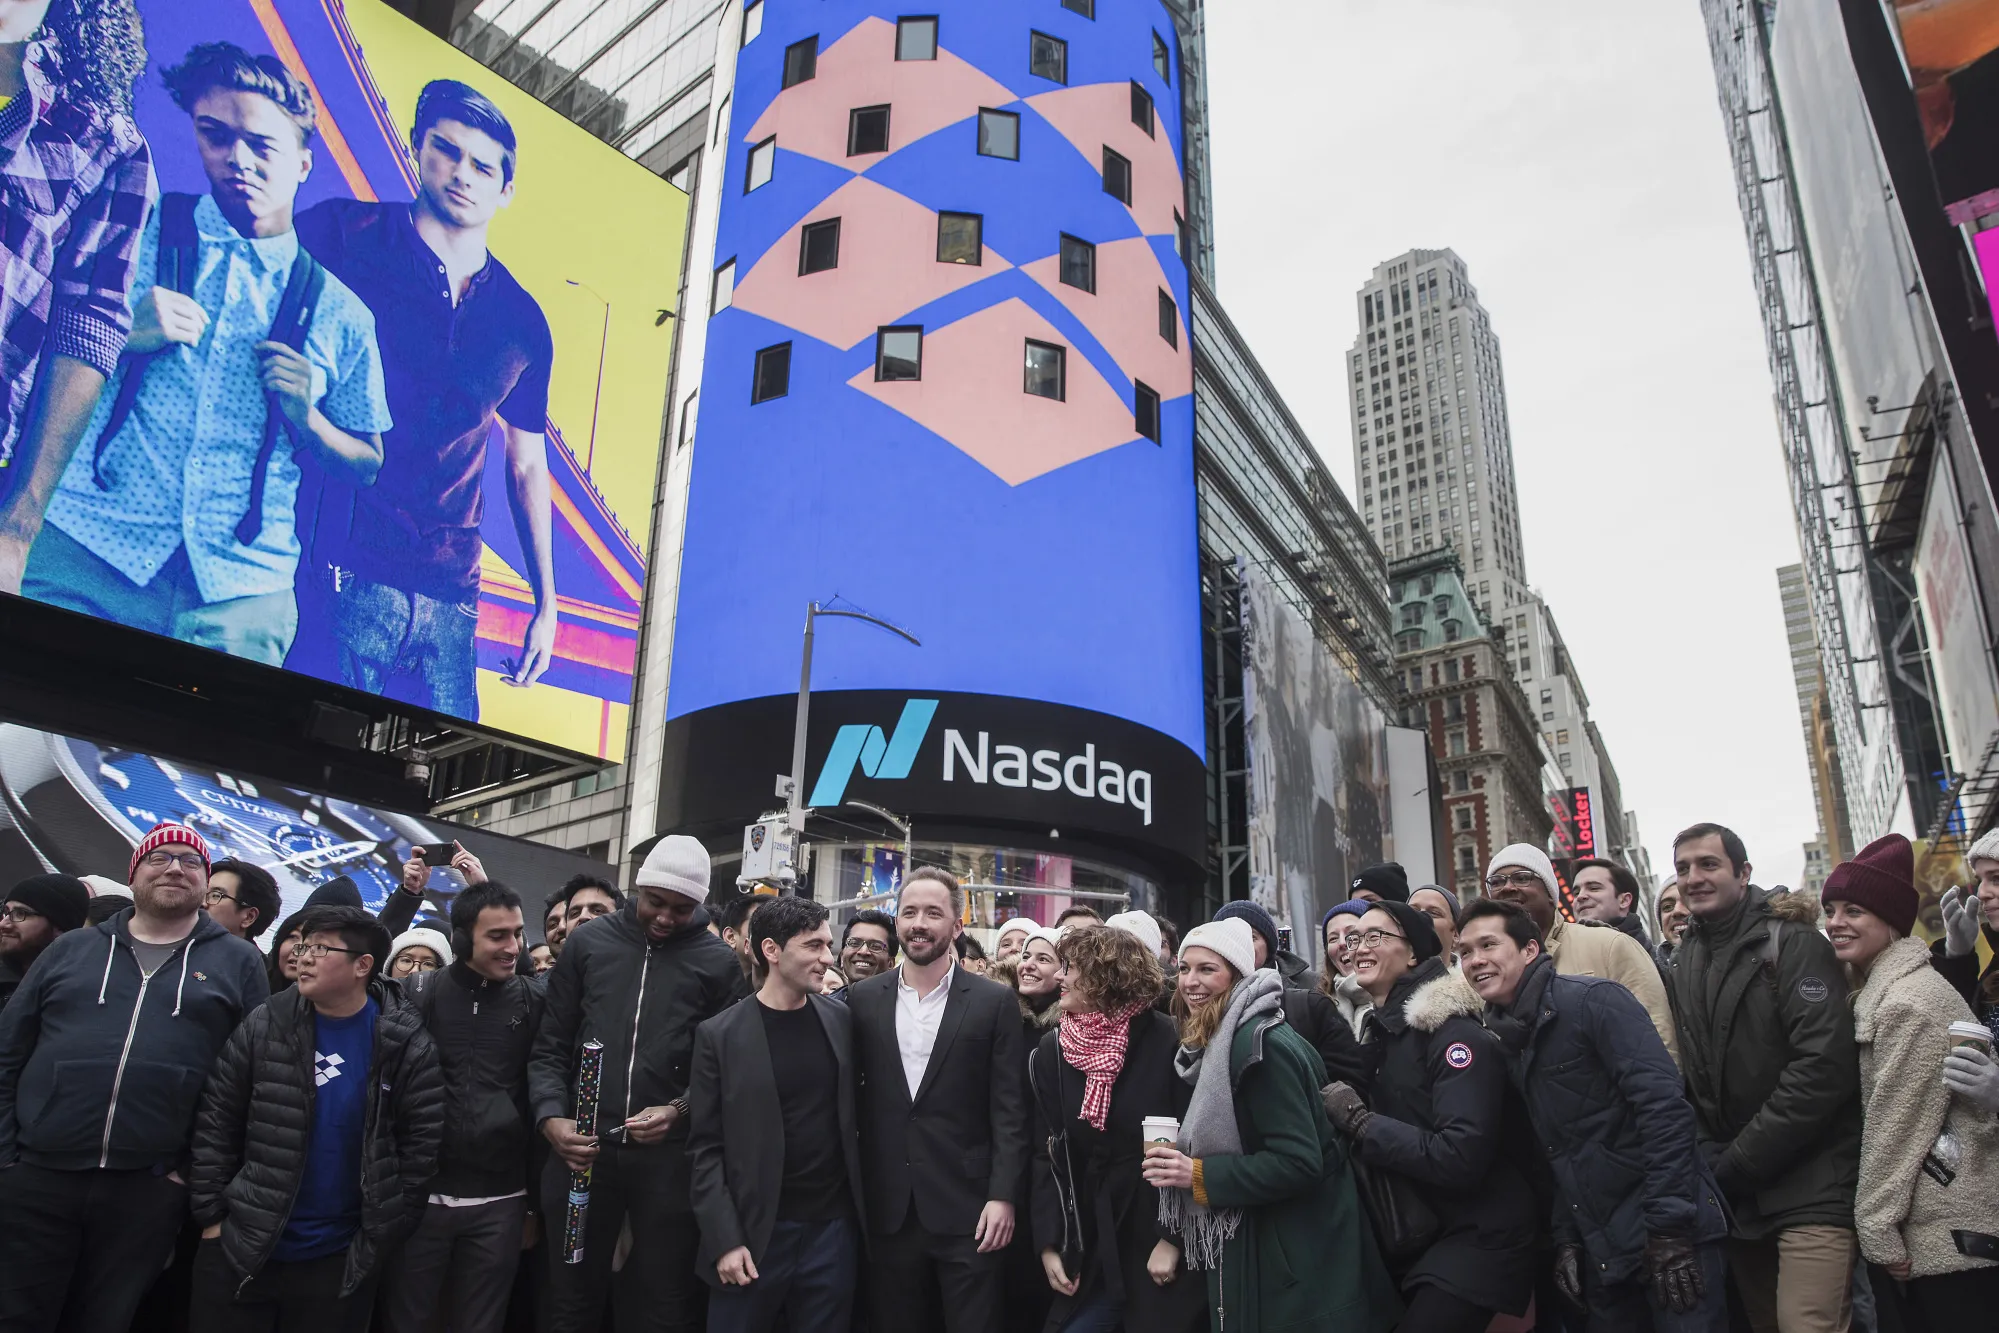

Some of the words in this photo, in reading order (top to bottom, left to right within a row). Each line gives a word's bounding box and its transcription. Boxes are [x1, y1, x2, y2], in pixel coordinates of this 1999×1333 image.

[201, 789, 292, 824] CITIZEN
[943, 729, 1152, 826] Nasdaq
[1573, 792, 1593, 850] Locker
